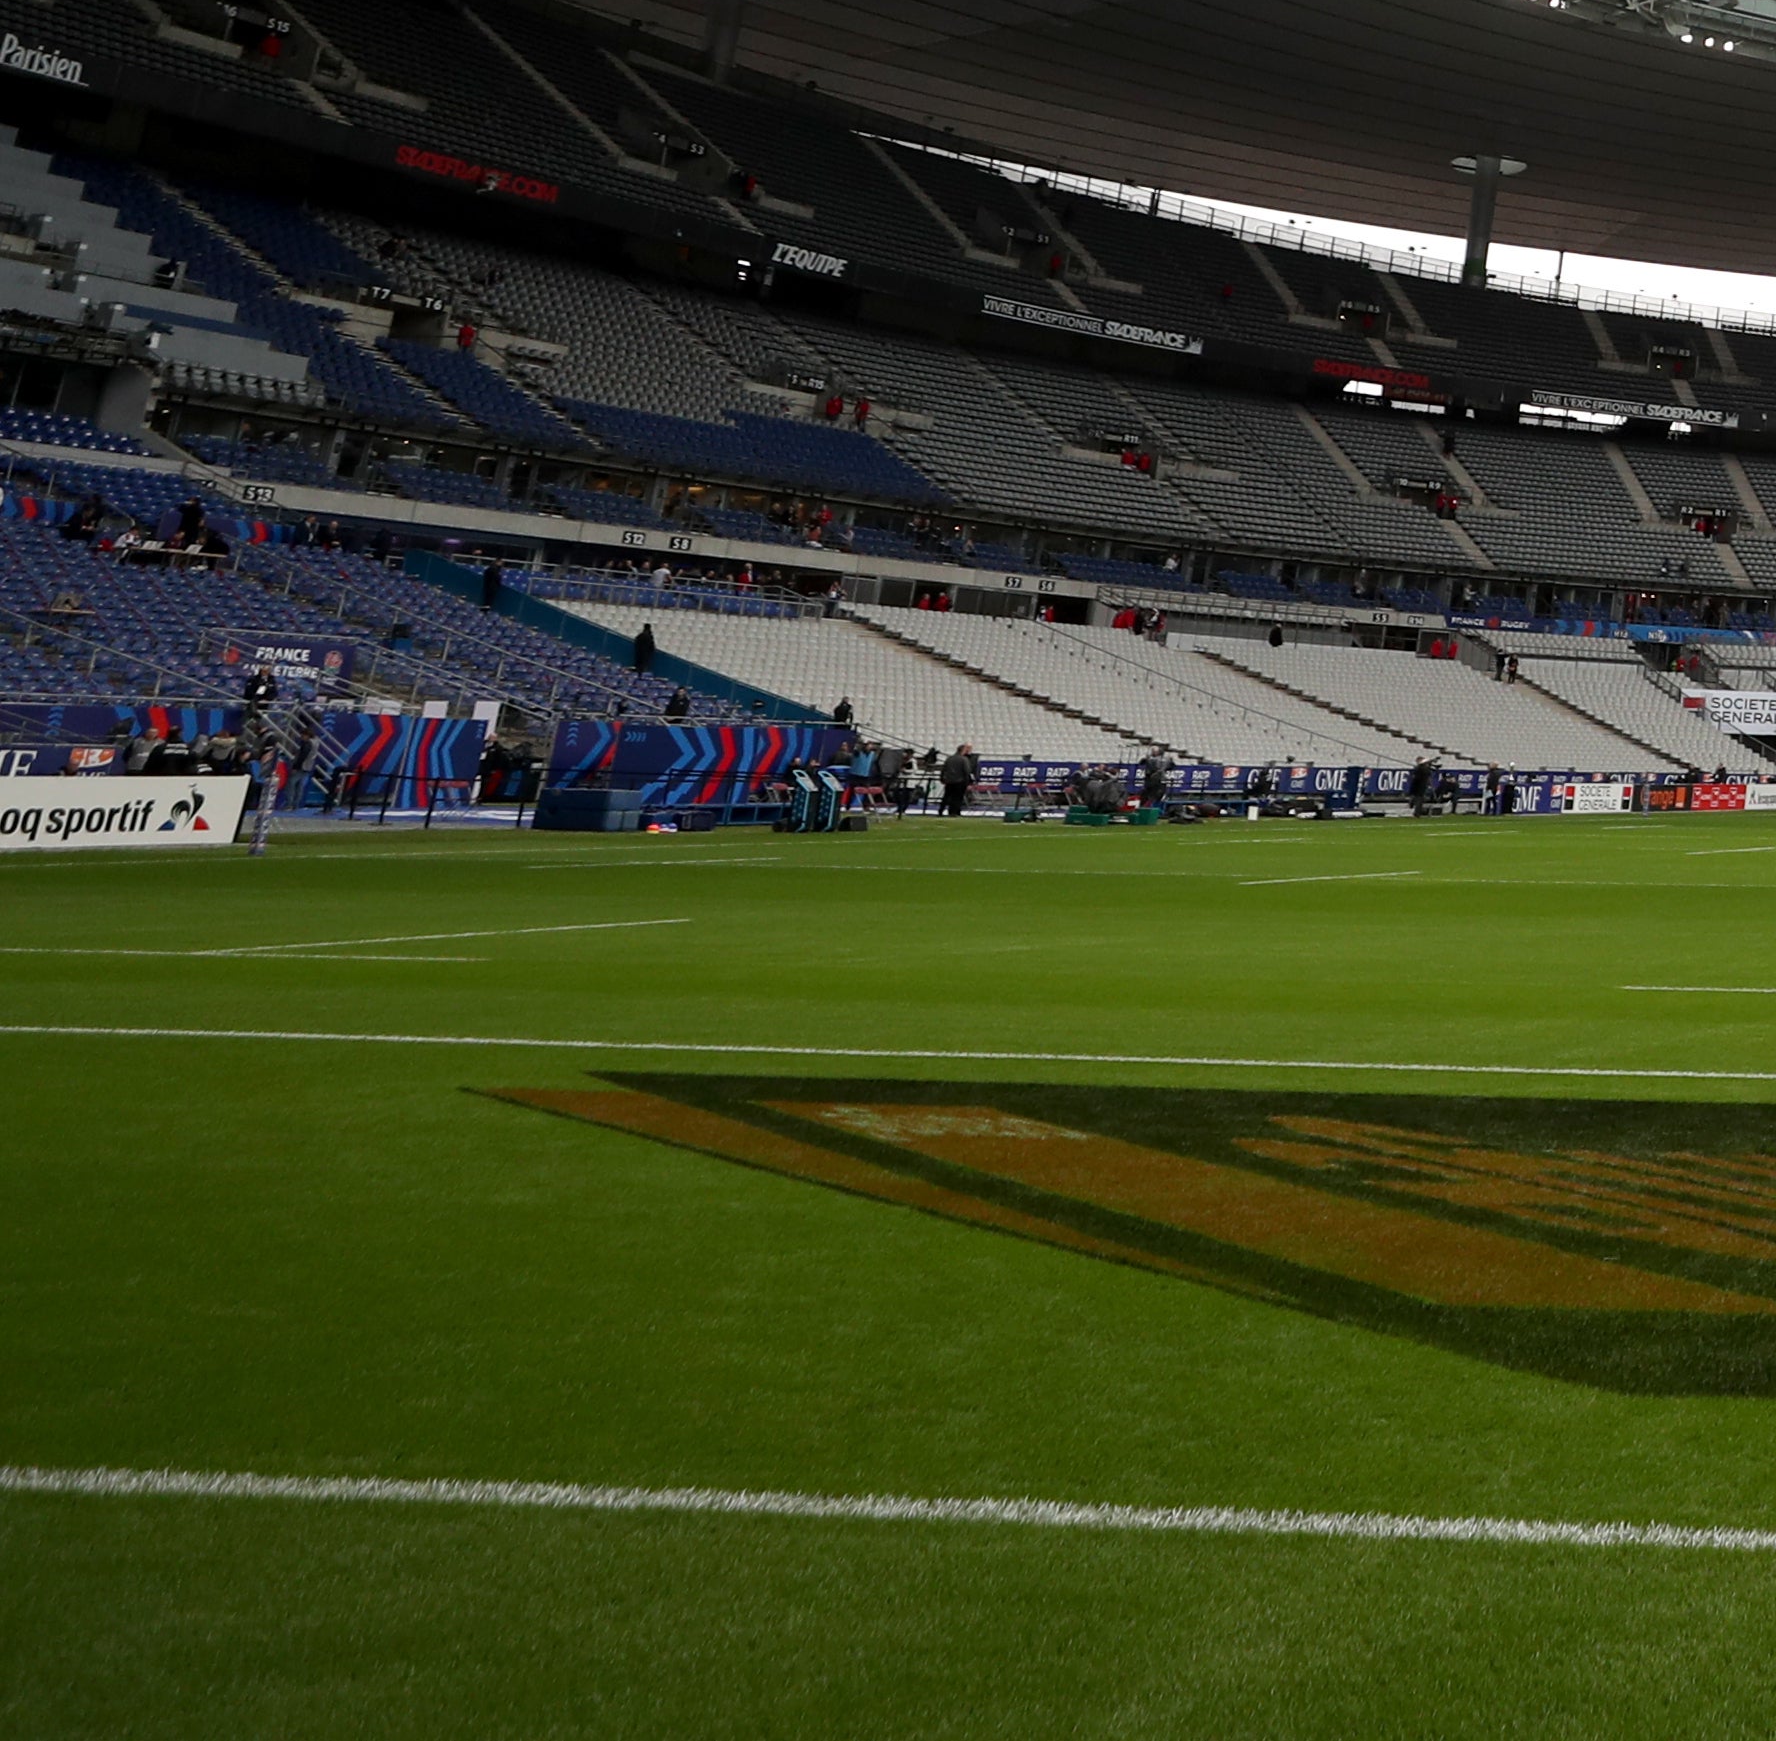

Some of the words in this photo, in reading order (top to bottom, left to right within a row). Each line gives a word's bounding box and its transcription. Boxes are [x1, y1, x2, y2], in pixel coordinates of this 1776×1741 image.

[0, 33, 84, 83] Parisien
[771, 243, 848, 279] L'EQUIPE
[372, 286, 391, 299] T7
[424, 296, 443, 310] T6
[983, 297, 1015, 316] VIVRE
[1017, 307, 1103, 334] L'EXCEPTIONNEL
[1531, 392, 1561, 406] VIVRE
[1563, 396, 1646, 415] L'EXCEPTIONNEL
[624, 532, 644, 545] S12
[1007, 577, 1020, 588] S7
[1450, 616, 1485, 627] FRANCE
[255, 646, 311, 662] FRANCE
[980, 767, 1005, 777] RATP
[1013, 767, 1038, 777] RATP
[1046, 767, 1070, 777] RATP
[1191, 770, 1212, 780] RATP
[1315, 770, 1349, 791] GMF
[1377, 770, 1410, 791] GMF
[1579, 786, 1612, 797] SOCIETE
[1578, 799, 1617, 811] GENERALE
[0, 807, 43, 842] oq
[45, 799, 156, 842] sportif
